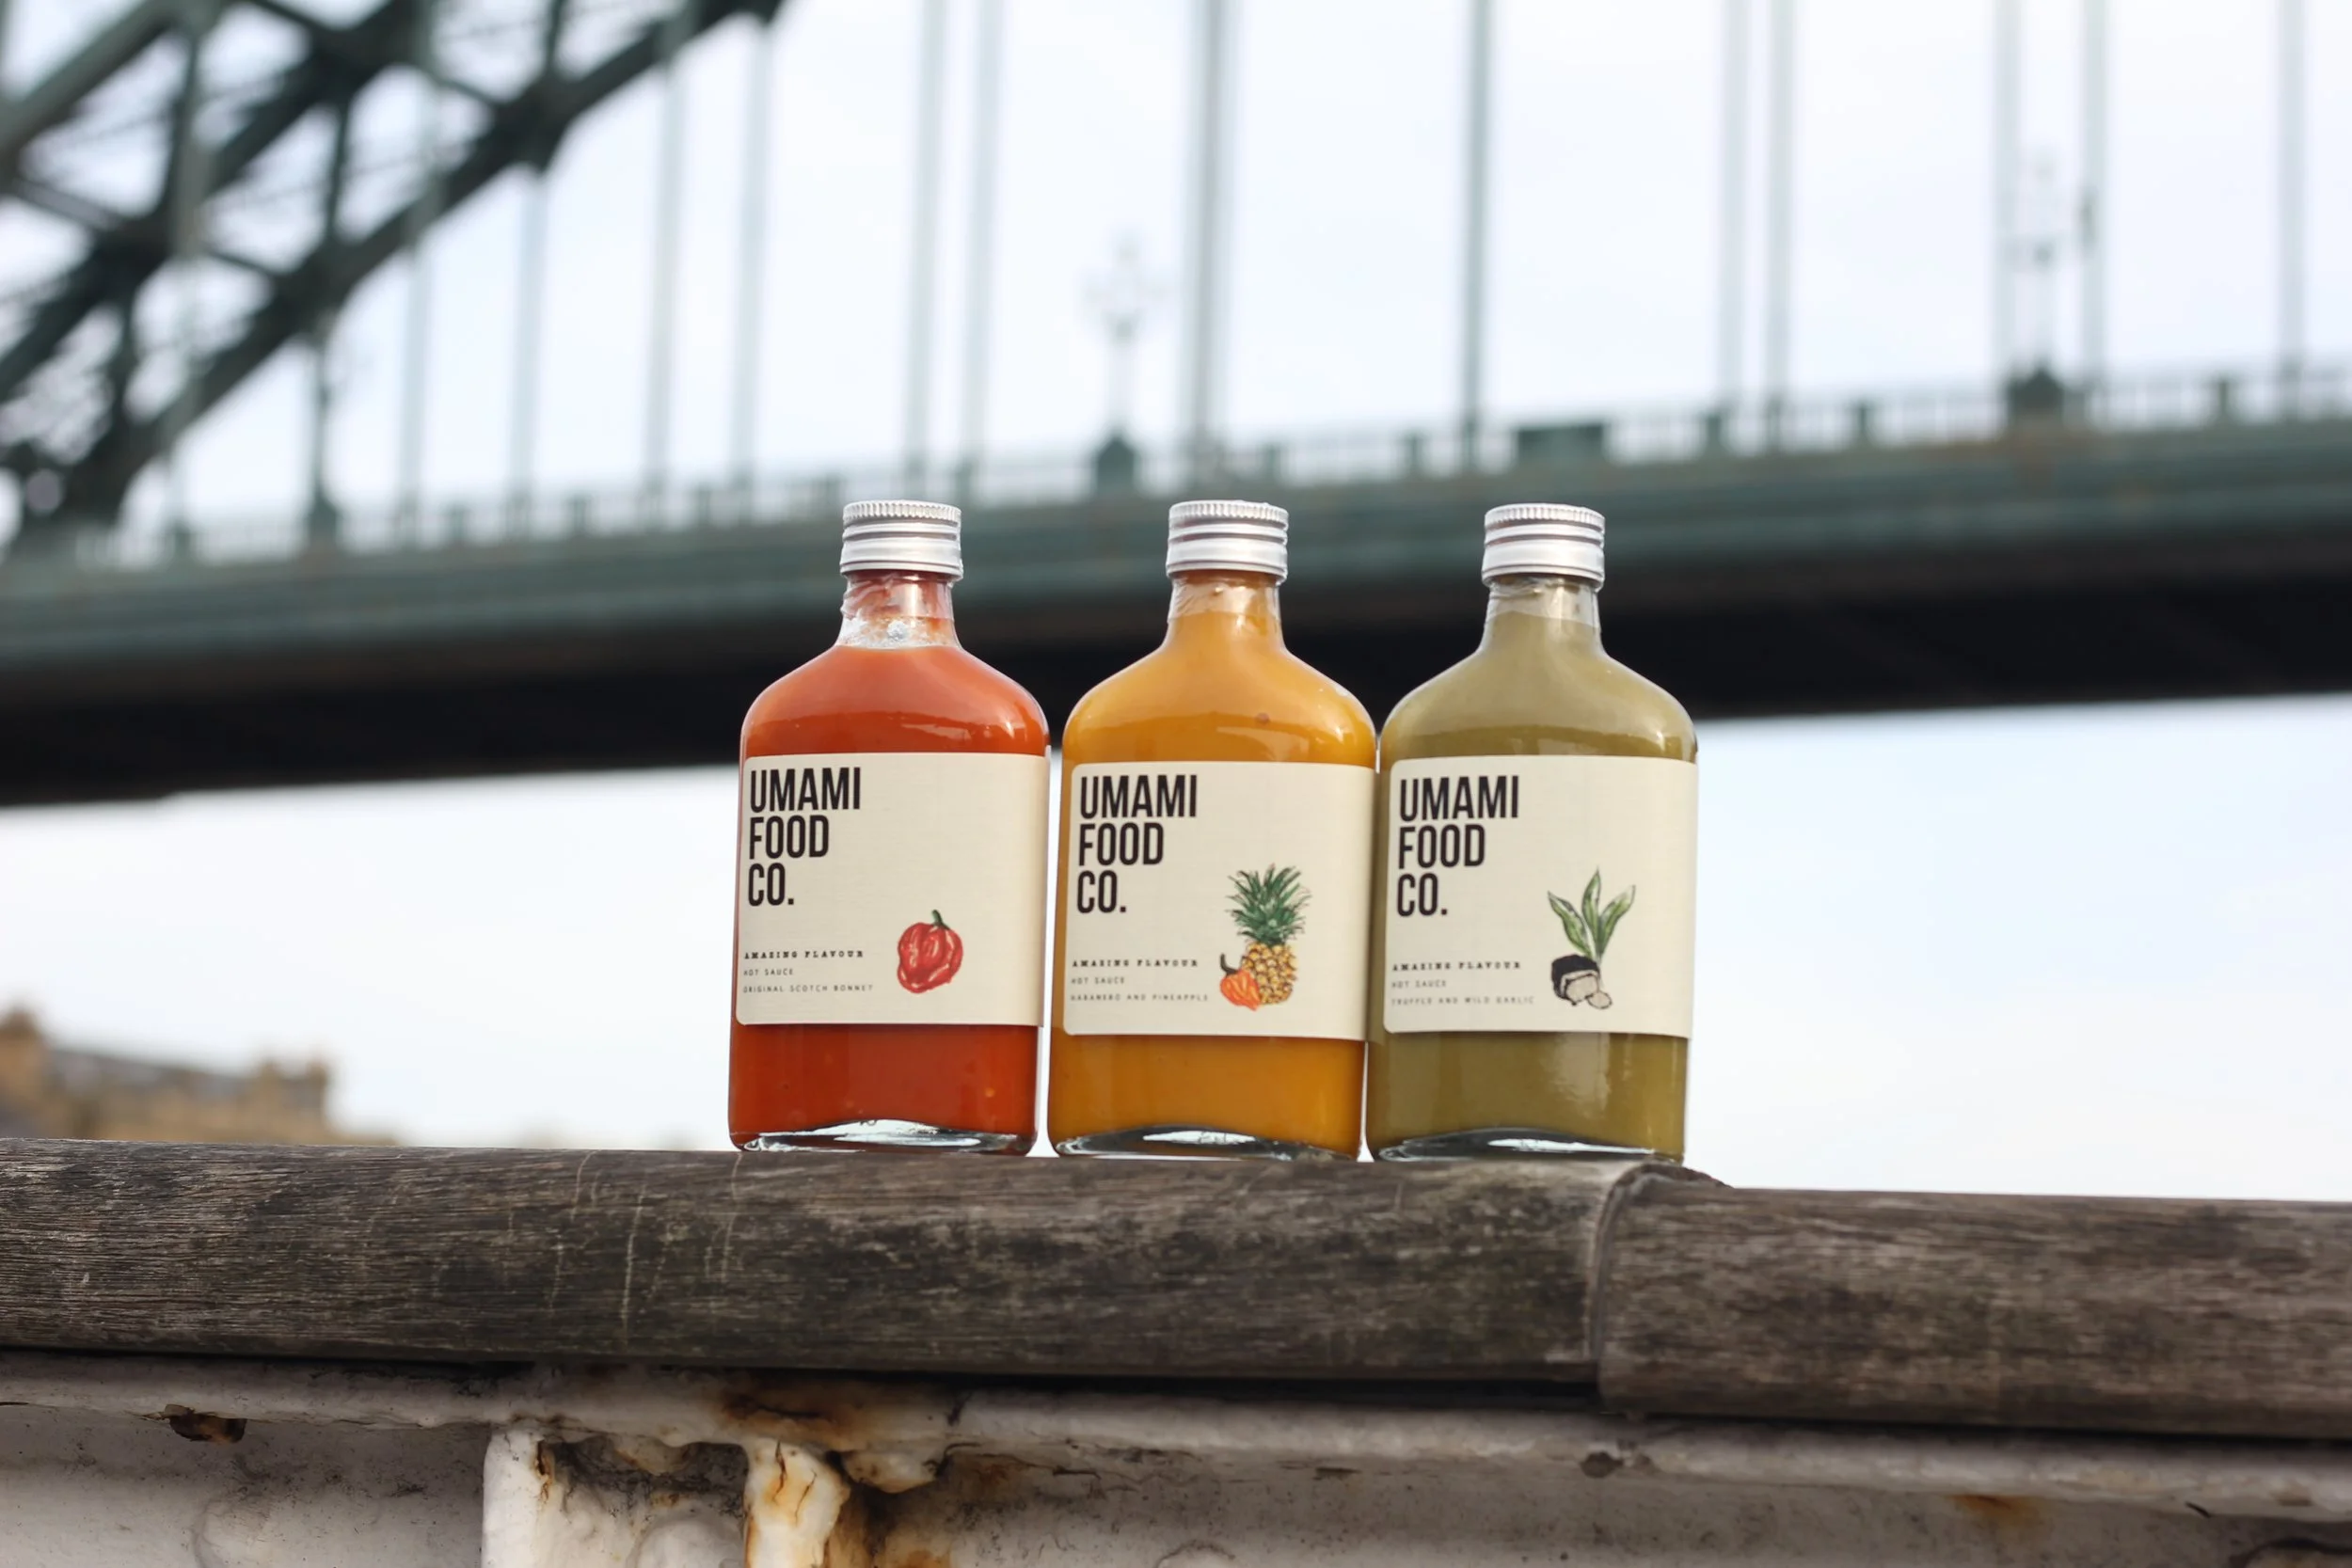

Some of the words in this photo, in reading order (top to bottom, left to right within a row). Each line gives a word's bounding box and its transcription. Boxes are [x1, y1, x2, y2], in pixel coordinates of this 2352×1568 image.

[751, 767, 861, 813] UMAMI
[1080, 775, 1197, 819] UMAMI
[1400, 775, 1518, 821] UMAMI
[749, 815, 829, 860] FOOD
[1079, 822, 1164, 866] FOOD
[1399, 824, 1485, 869] FOOD
[748, 863, 794, 907] CO.
[1077, 870, 1126, 913] CO.
[1397, 873, 1447, 916] CO.
[744, 951, 798, 959] AMAZING
[1392, 962, 1451, 971] AMAZING
[1459, 961, 1520, 970] FLAVOUR
